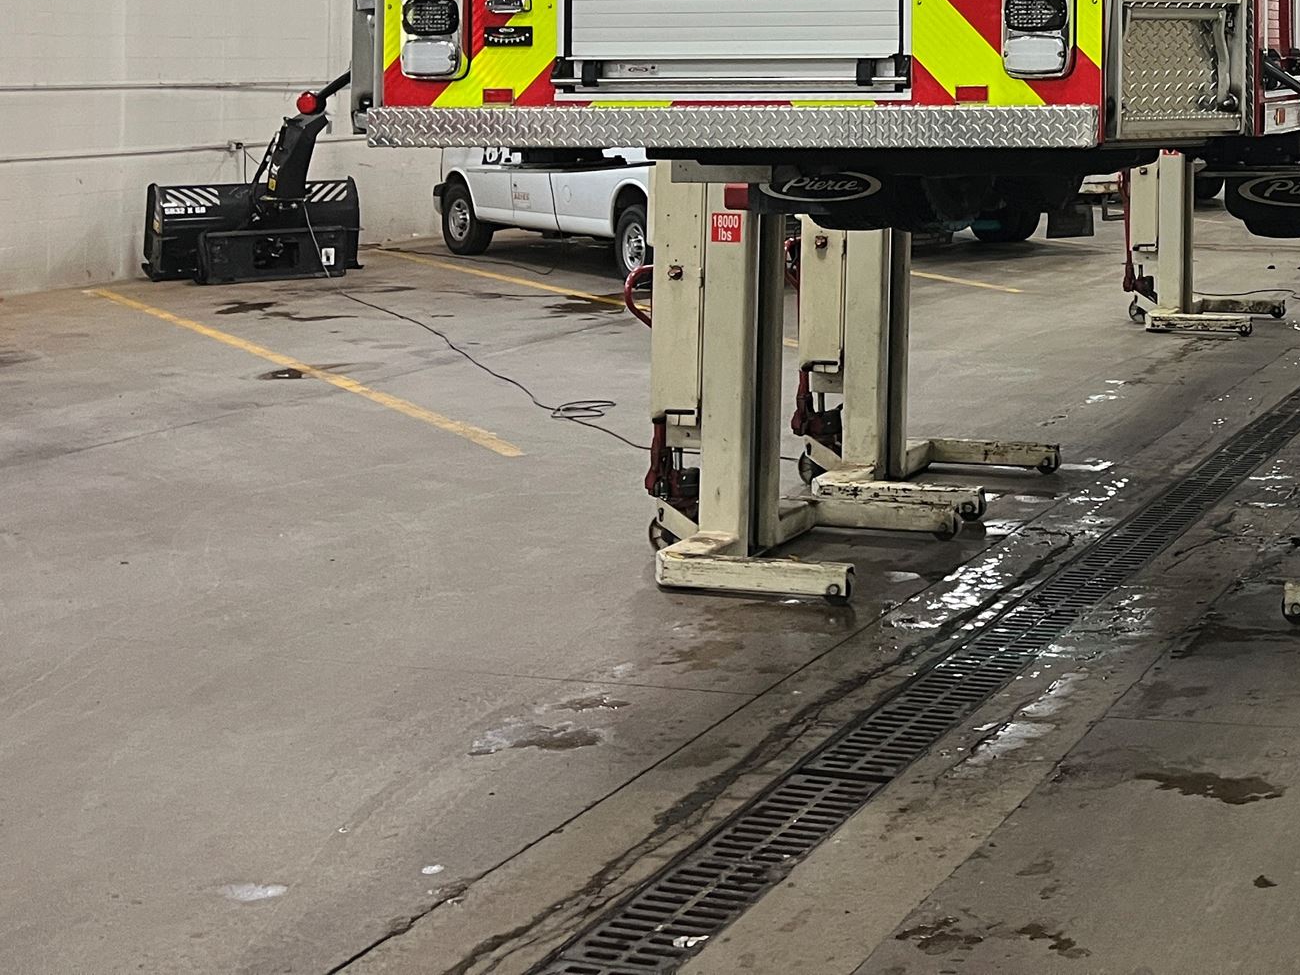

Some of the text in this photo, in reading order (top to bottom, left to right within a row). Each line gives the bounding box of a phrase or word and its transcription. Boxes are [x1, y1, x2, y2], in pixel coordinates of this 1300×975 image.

[781, 177, 859, 193] Pierce
[712, 214, 739, 228] 18000
[718, 228, 732, 241] lbs
